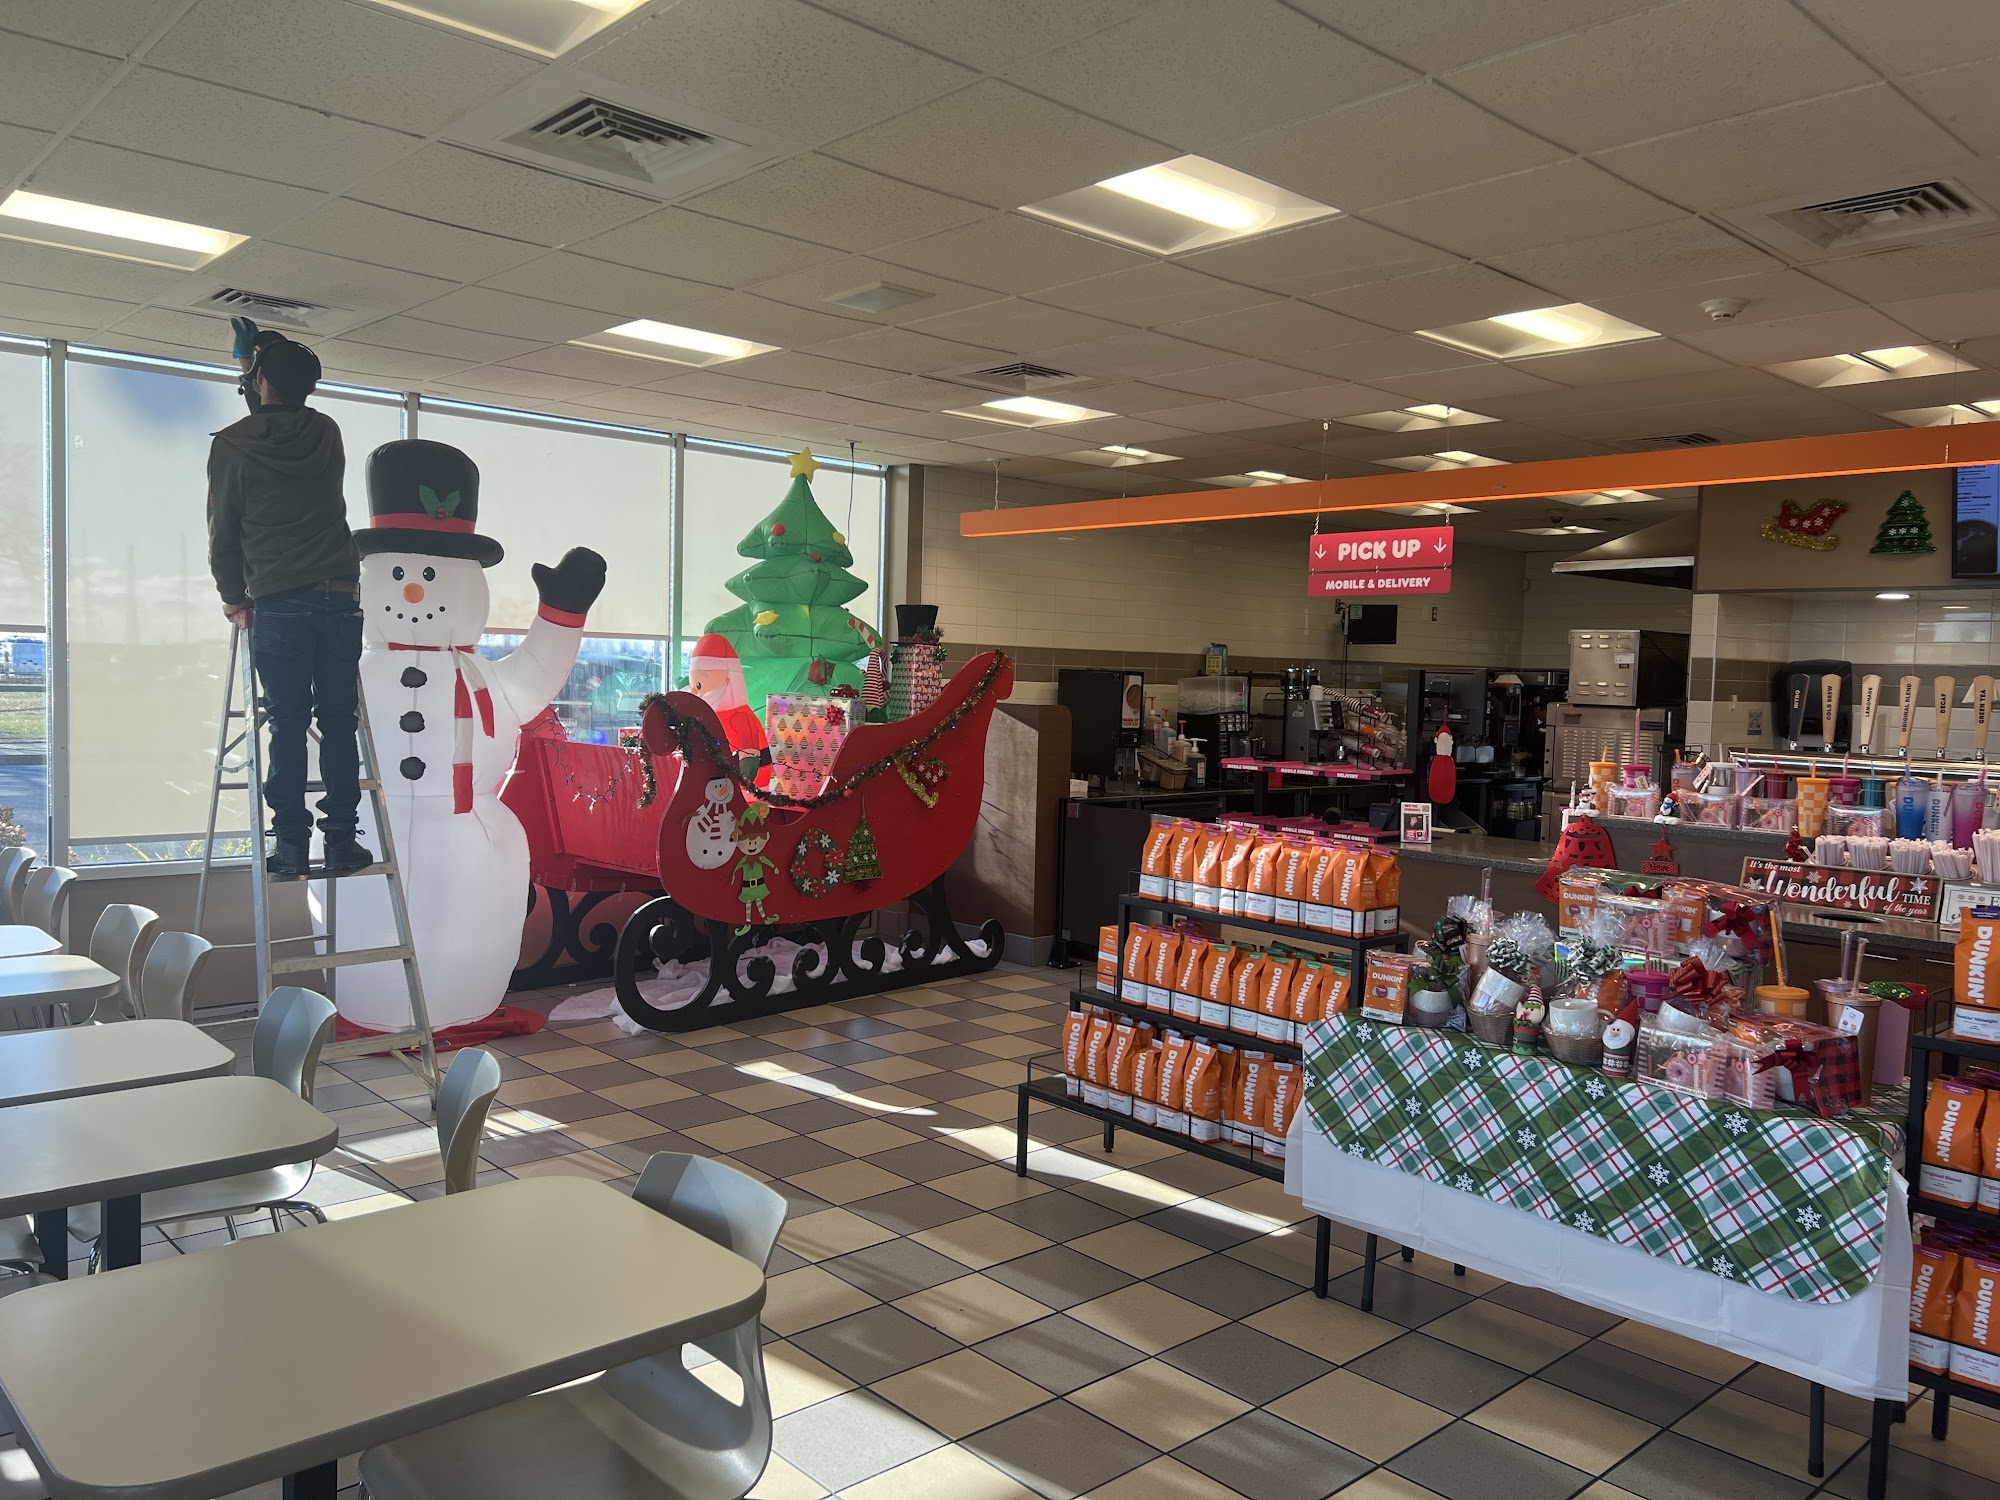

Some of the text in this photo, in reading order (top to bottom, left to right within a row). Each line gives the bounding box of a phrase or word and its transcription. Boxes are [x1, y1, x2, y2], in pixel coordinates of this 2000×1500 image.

[1338, 539, 1421, 561] PICK UP
[1325, 577, 1431, 590] MOBILE & DELIVERY
[1902, 705, 1910, 732] ORIGINAL
[1147, 833, 1166, 872] DUNKIN'
[1174, 837, 1189, 877] DUNKIN'
[1284, 851, 1300, 896] DUNKIN'
[1749, 860, 1801, 873] It's the most
[1312, 856, 1329, 900] DUNKIN'
[1340, 859, 1355, 905] DUNKIN'
[1563, 892, 1594, 902] DUNKIN'
[1766, 870, 1901, 909] Wonderful
[1902, 892, 1931, 905] TIME
[1883, 903, 1927, 916] of the year
[1128, 936, 1142, 977] DUNKIN'
[1155, 942, 1168, 984] DUNKIN'
[1180, 948, 1197, 990] DUNKIN'
[1210, 956, 1226, 999] DUNKIN'
[1372, 972, 1404, 984] DUNKIN'
[1967, 926, 1993, 1004] DUNKIN'
[1238, 962, 1254, 1005] DUNKIN'
[1266, 968, 1282, 1012] DUNKIN'
[1296, 974, 1314, 1018] DUNKIN'
[1067, 1023, 1080, 1075] DUNKIN'
[1088, 1031, 1102, 1082] DUNKIN'
[1110, 1036, 1126, 1090] DUNKIN'
[1161, 1050, 1177, 1106] DUNKIN'
[1185, 1057, 1203, 1112] DUNKIN'
[1243, 1063, 1259, 1120] DUNKIN'
[1273, 1075, 1289, 1132] DUNKIN'
[1936, 1099, 1961, 1163] DUNKIN'
[1910, 1264, 1934, 1328] DUNKIN'
[1973, 1278, 1994, 1345] DUNKIN'
